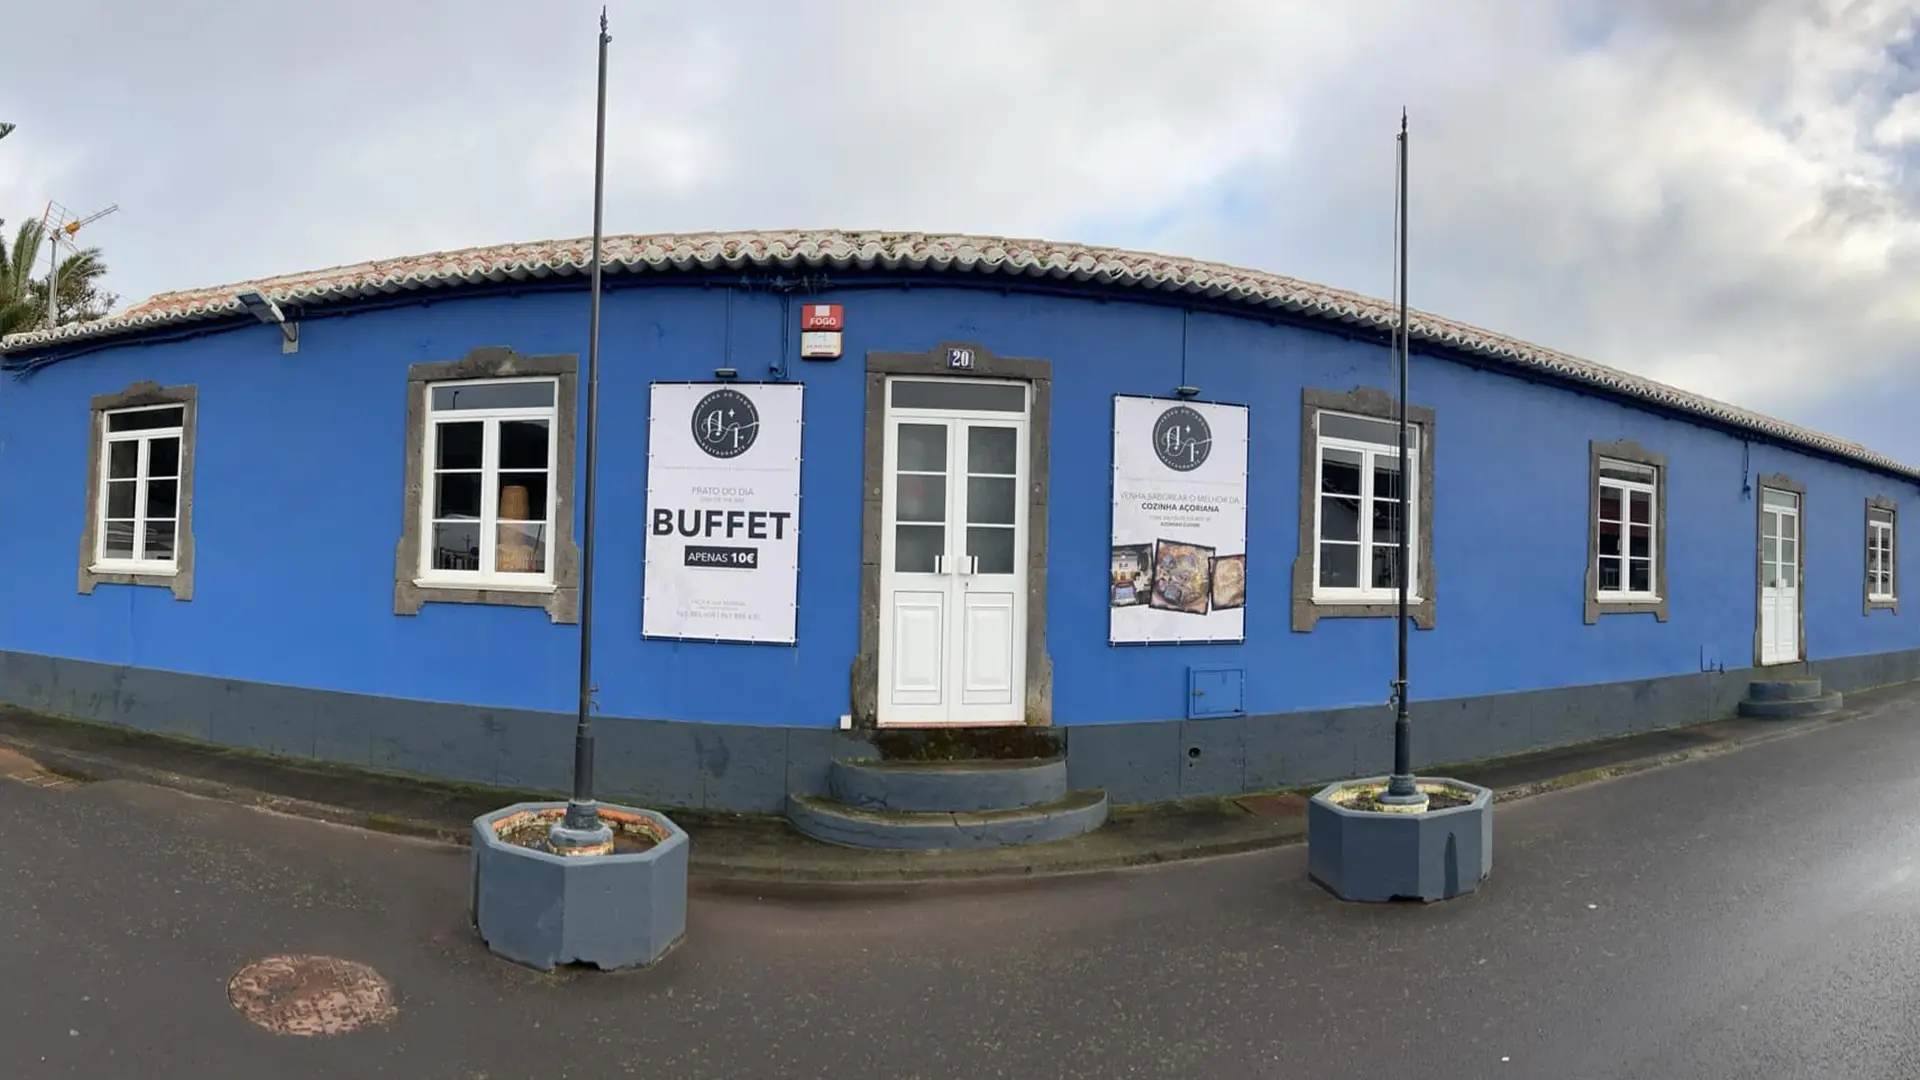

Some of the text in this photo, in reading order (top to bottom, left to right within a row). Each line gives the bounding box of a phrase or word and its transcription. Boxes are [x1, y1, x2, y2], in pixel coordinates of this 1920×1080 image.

[809, 317, 837, 326] FOGO
[952, 350, 969, 367] 20
[692, 486, 754, 496] PRATO DO DIA
[1120, 491, 1146, 501] VENHA
[1189, 494, 1196, 502] O
[1141, 502, 1220, 513] COZINHA AÇORIANA
[652, 508, 791, 540] BUFFET
[687, 552, 755, 564] APENAS 10€
